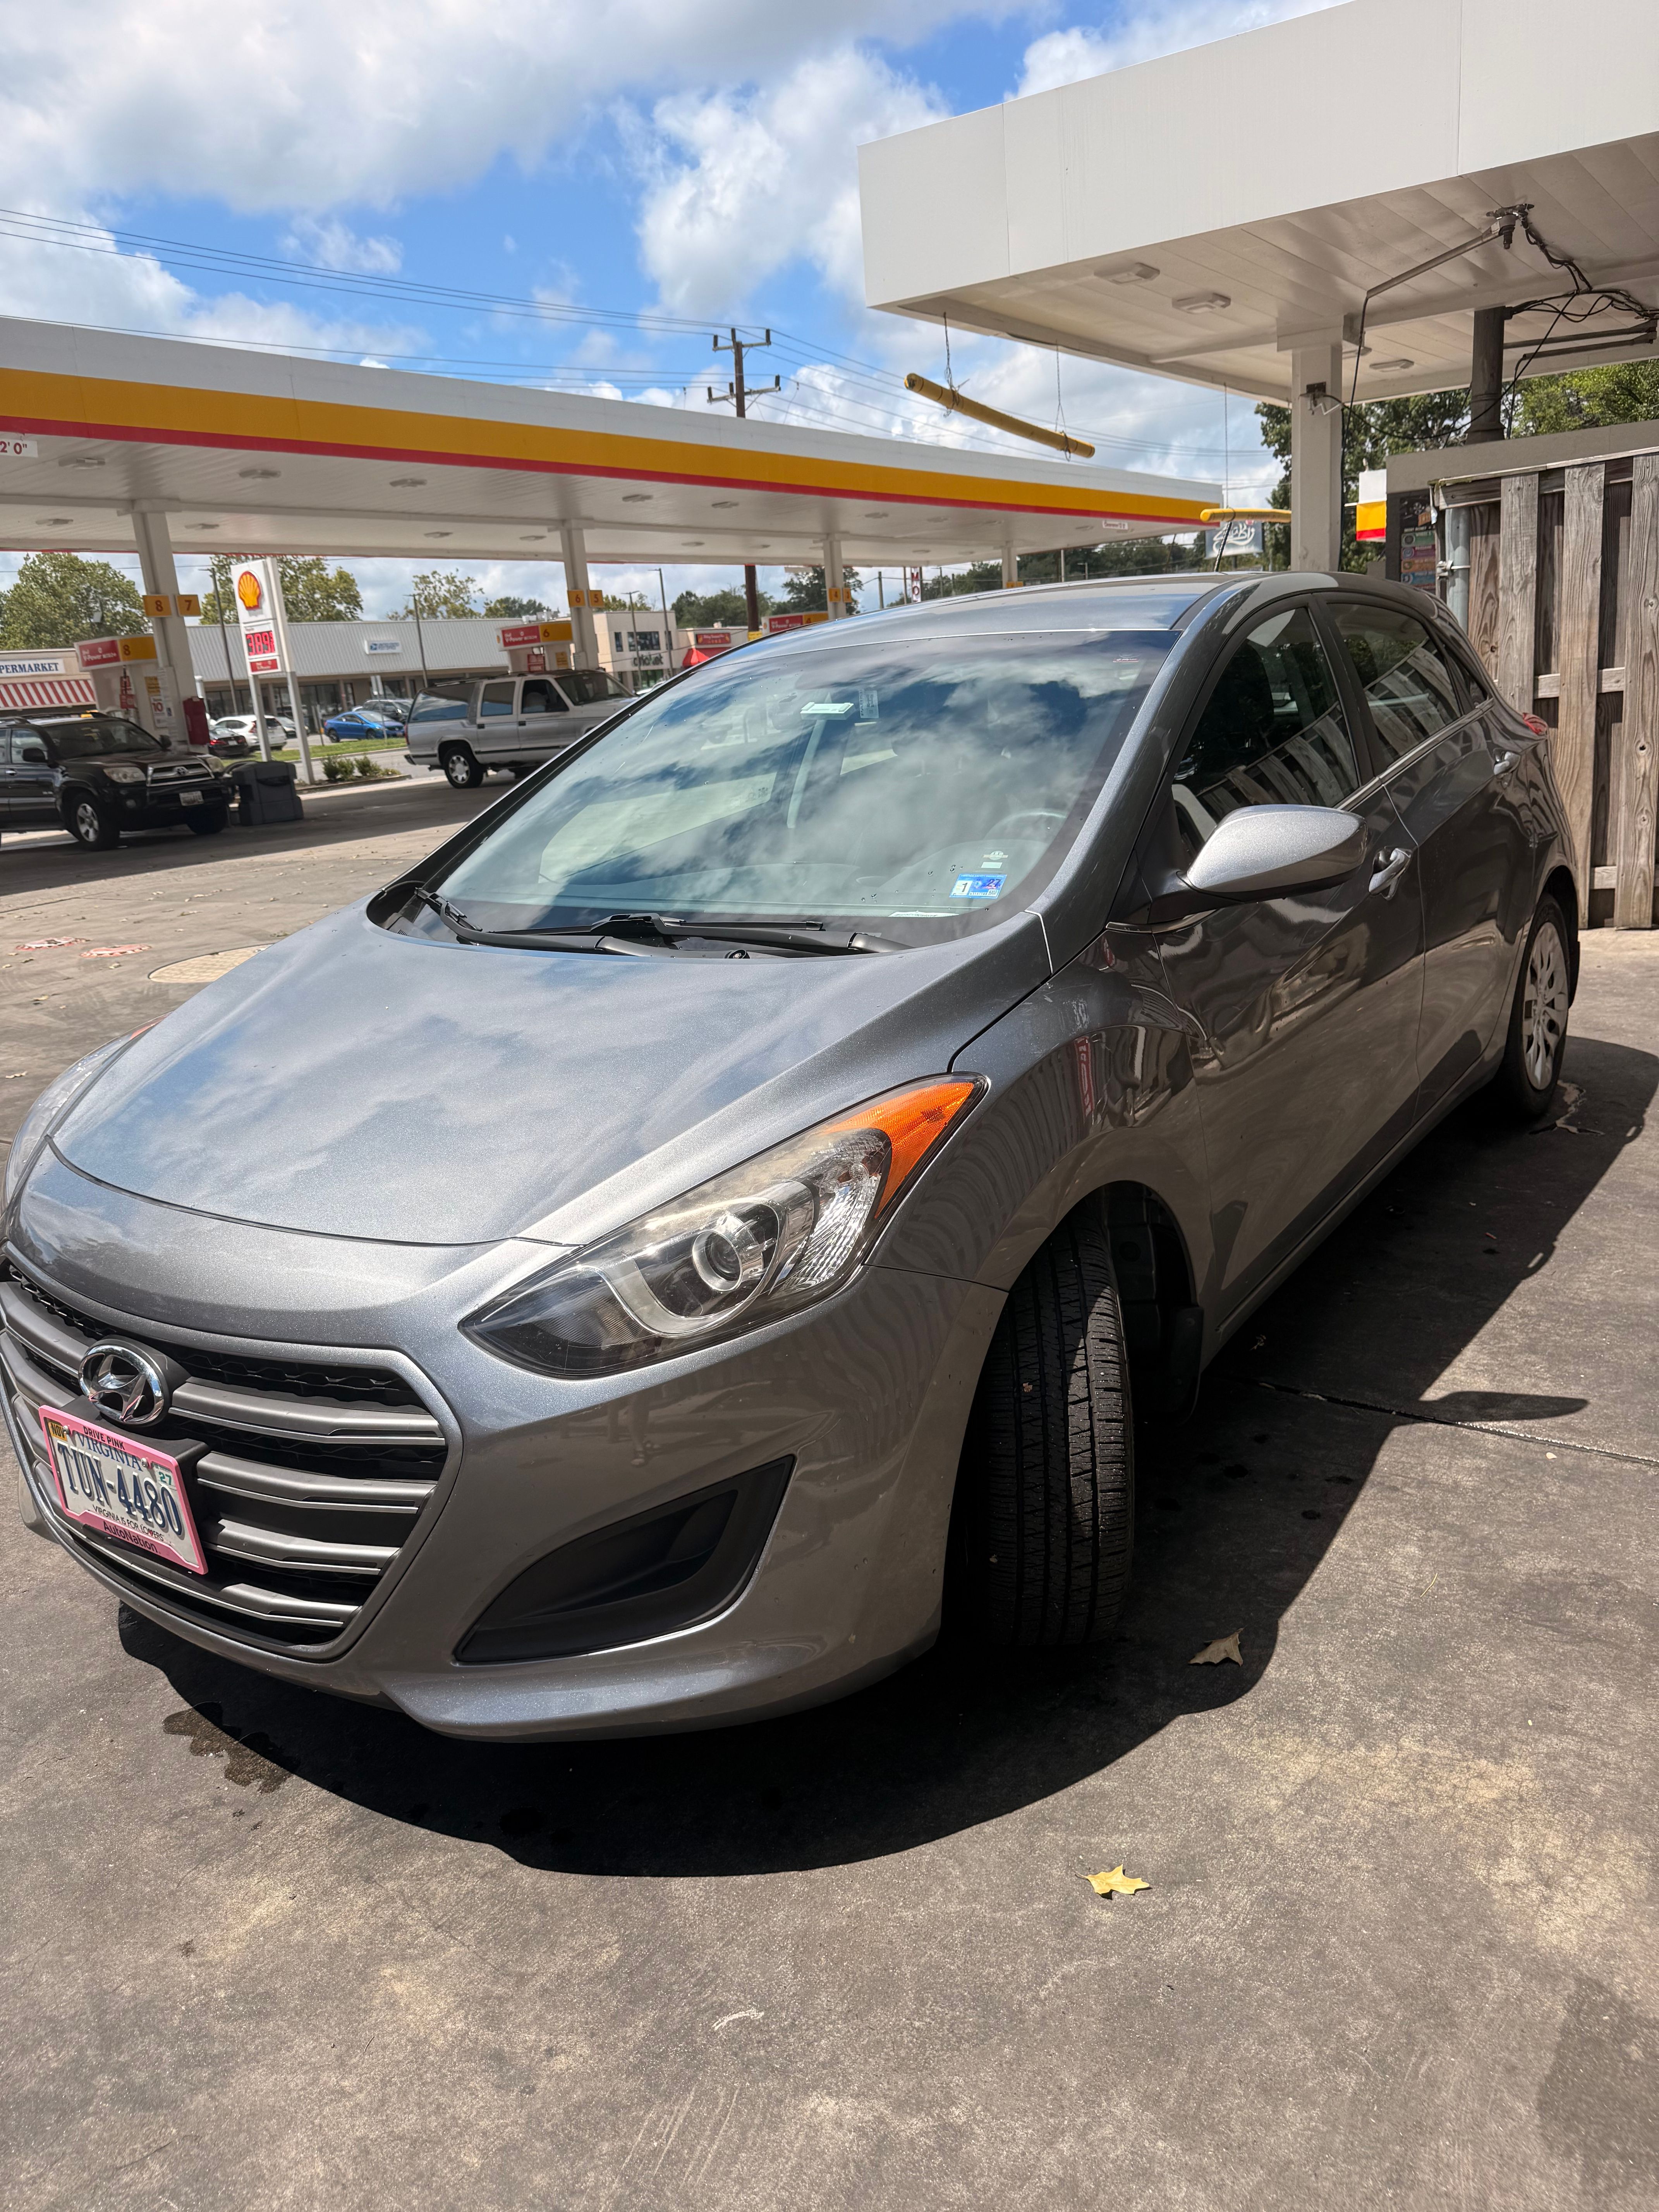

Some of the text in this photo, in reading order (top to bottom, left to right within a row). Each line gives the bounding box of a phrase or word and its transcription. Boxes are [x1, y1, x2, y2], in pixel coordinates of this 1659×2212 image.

[575, 594, 581, 603] 6
[594, 594, 599, 603] 5
[155, 600, 163, 612] 8
[184, 599, 192, 611] 7
[543, 629, 550, 637] 6
[123, 644, 131, 656] 8
[0, 663, 59, 673] PERMARKET
[962, 883, 968, 892] 1
[986, 879, 1002, 887] 27
[51, 1423, 65, 1439] NOV
[83, 1426, 125, 1450] DRIVE PINK
[77, 1433, 143, 1472] VIRGINIA
[159, 1472, 172, 1486] 27
[57, 1440, 182, 1536] TUN-4480
[93, 1504, 119, 1523] VIRGINIA
[120, 1516, 126, 1525] IS
[127, 1519, 140, 1531] FOR
[103, 1521, 158, 1553] AutoNation
